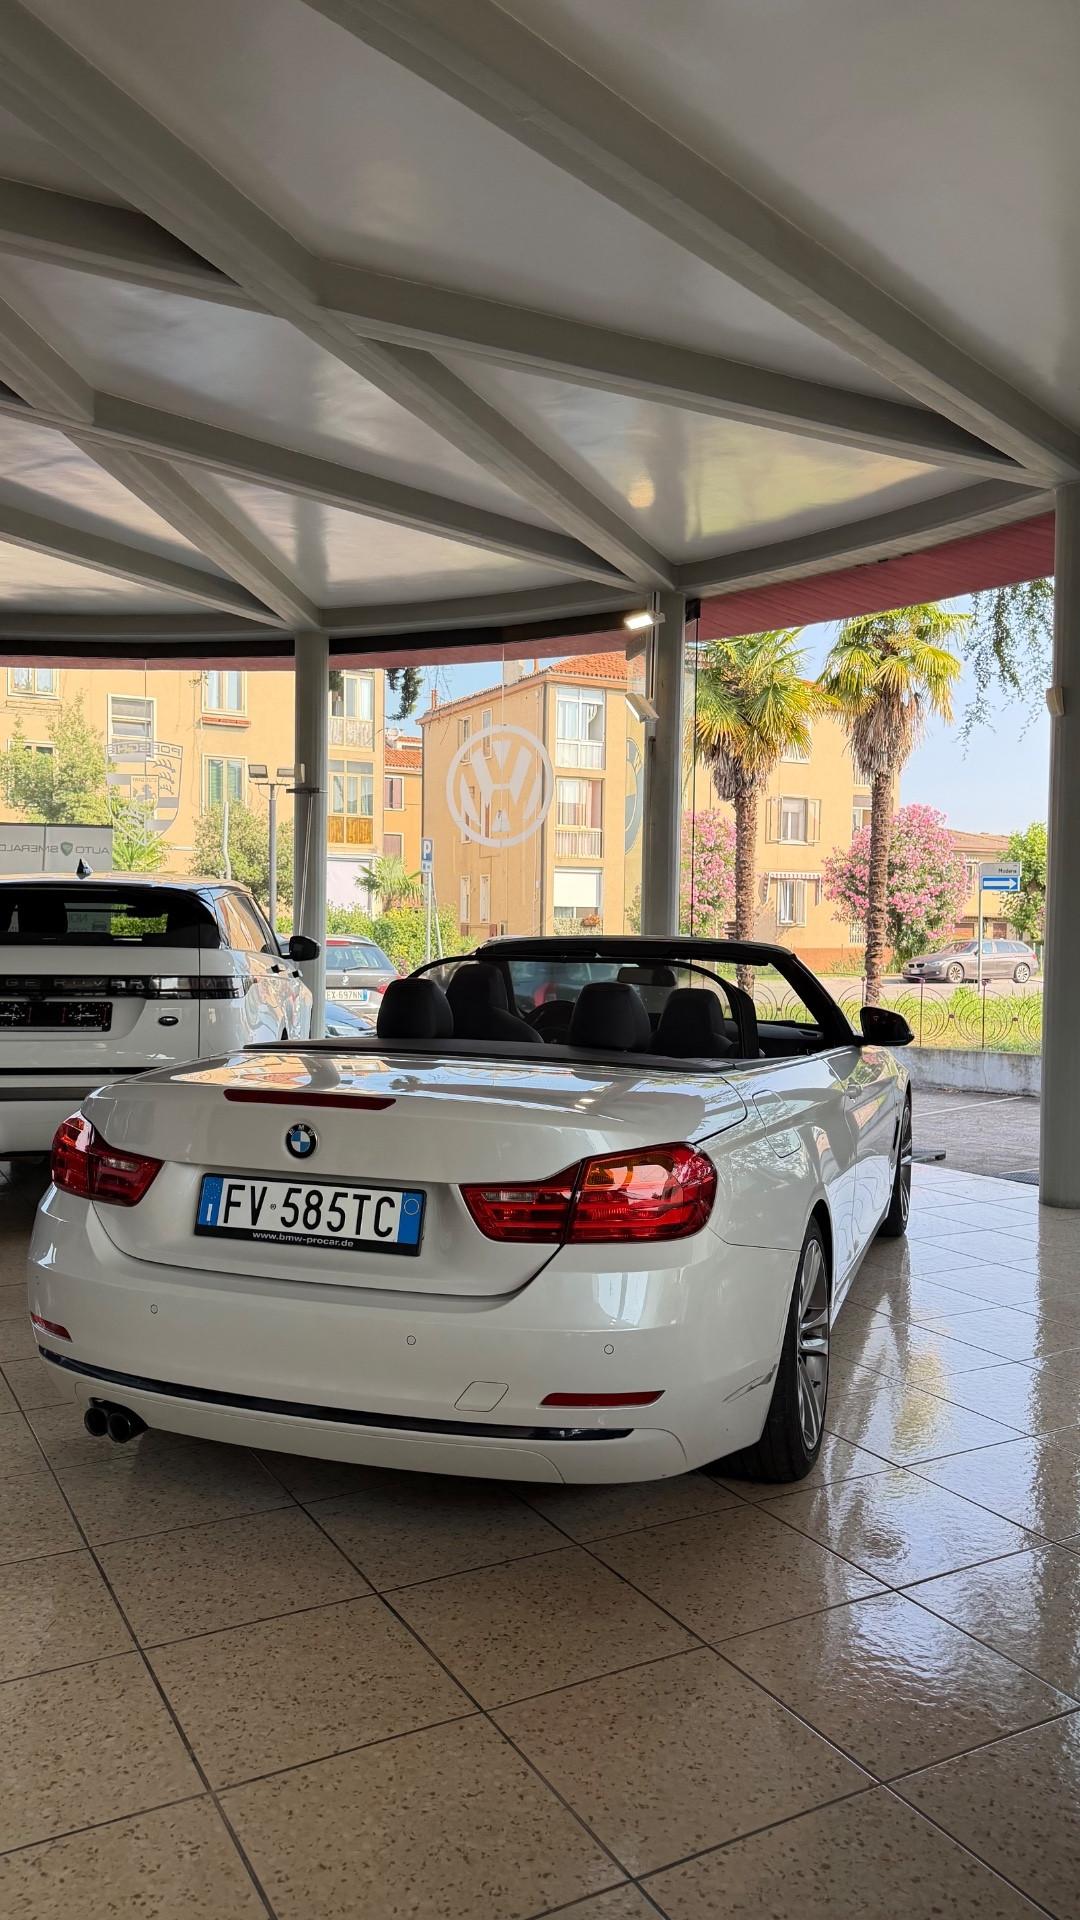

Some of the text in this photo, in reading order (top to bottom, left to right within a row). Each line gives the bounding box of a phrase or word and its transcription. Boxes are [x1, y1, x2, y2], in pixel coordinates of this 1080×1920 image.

[423, 841, 432, 860] P
[289, 1124, 316, 1136] BMW
[223, 1184, 267, 1226] FV
[280, 1187, 396, 1238] 585TC
[252, 1231, 354, 1248] www.bmw-procar.de
